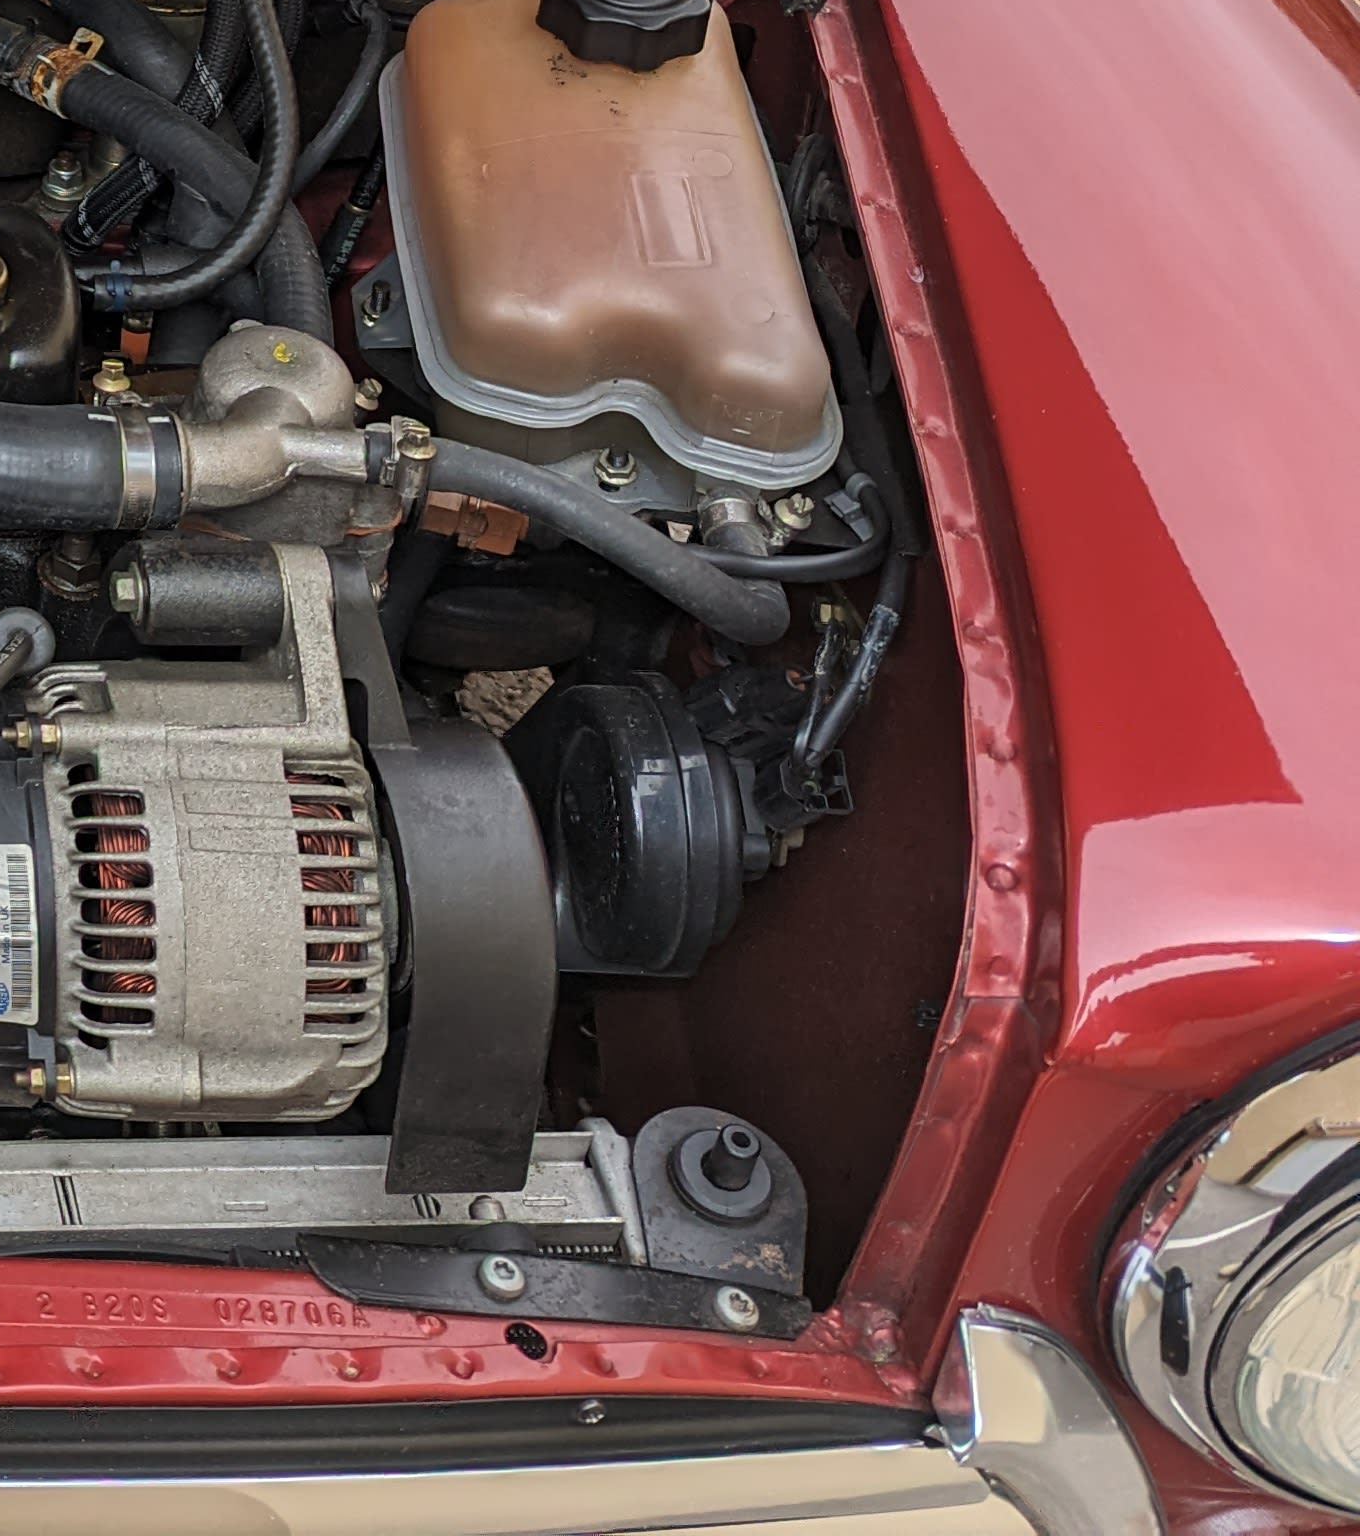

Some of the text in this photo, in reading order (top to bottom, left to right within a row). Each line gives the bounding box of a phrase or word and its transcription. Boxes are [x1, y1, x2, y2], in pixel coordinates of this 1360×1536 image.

[0, 905, 11, 964] Made in UK
